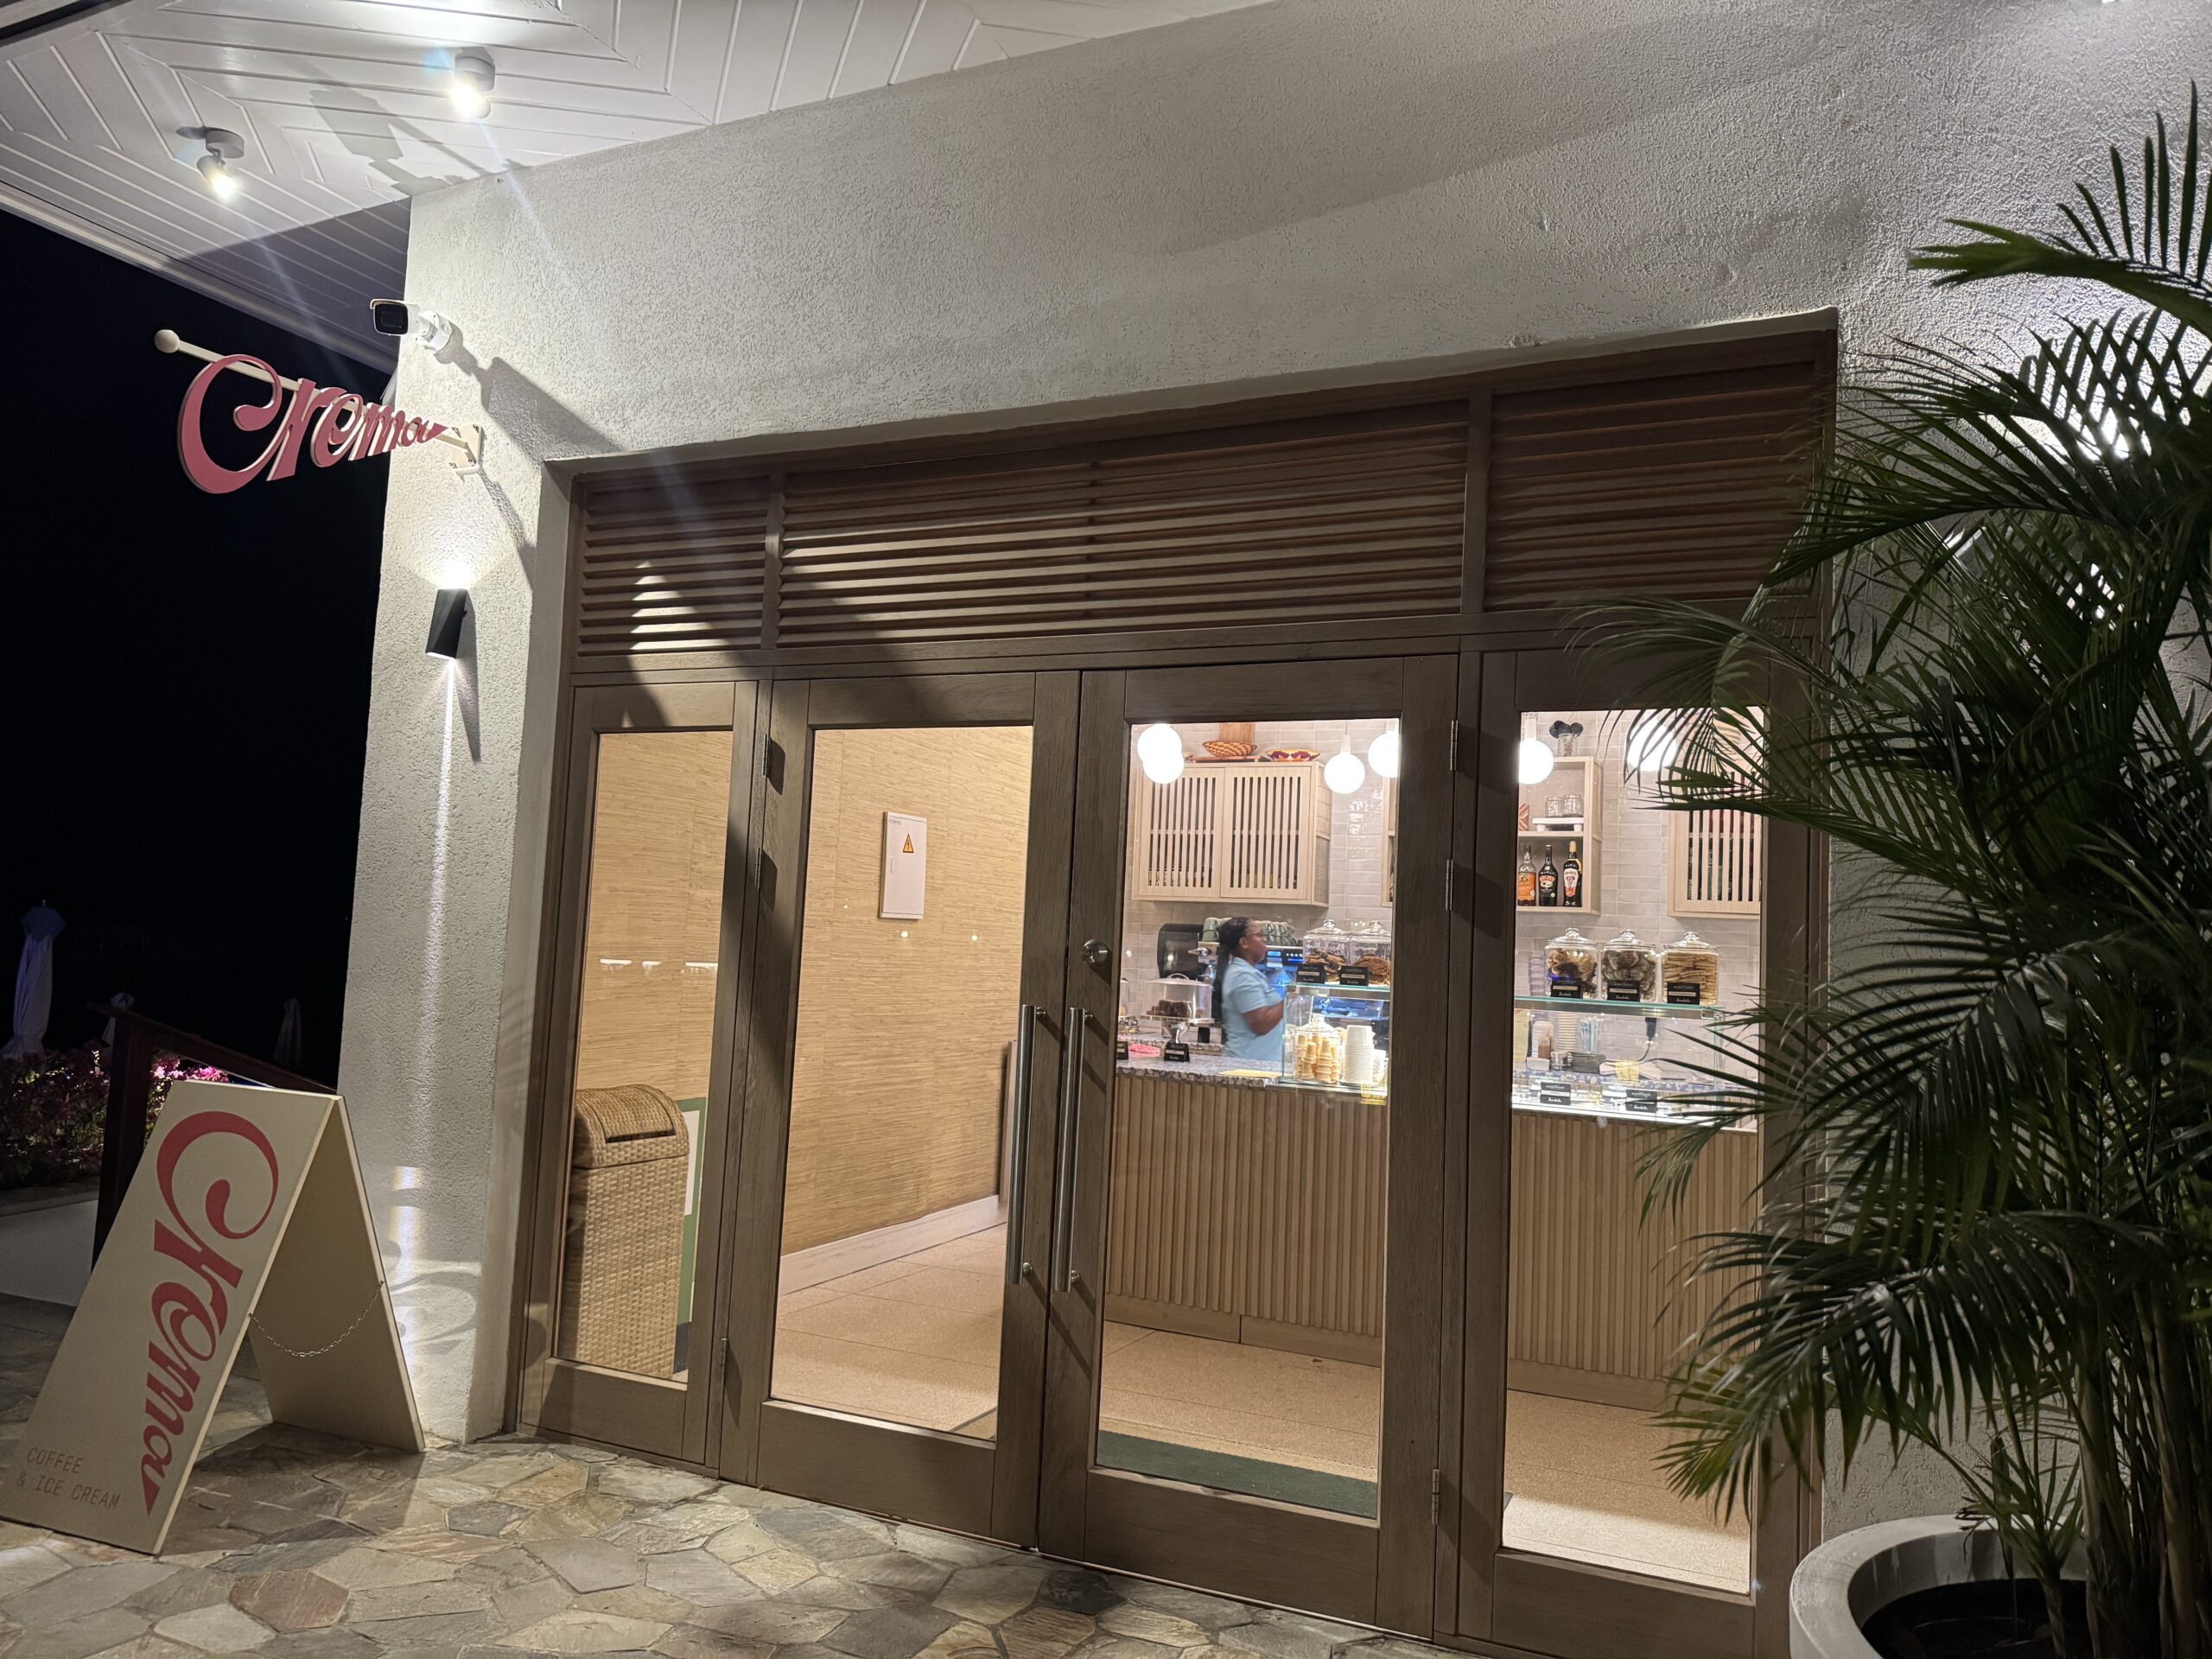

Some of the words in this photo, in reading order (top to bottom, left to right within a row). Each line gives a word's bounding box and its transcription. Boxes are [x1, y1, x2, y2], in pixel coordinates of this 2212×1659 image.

[177, 353, 449, 494] Crema
[140, 1110, 279, 1516] Crema
[16, 1471, 28, 1487] &
[35, 1474, 65, 1496] ICE
[71, 1484, 120, 1510] CREAM
[27, 1446, 84, 1474] COFFEE
